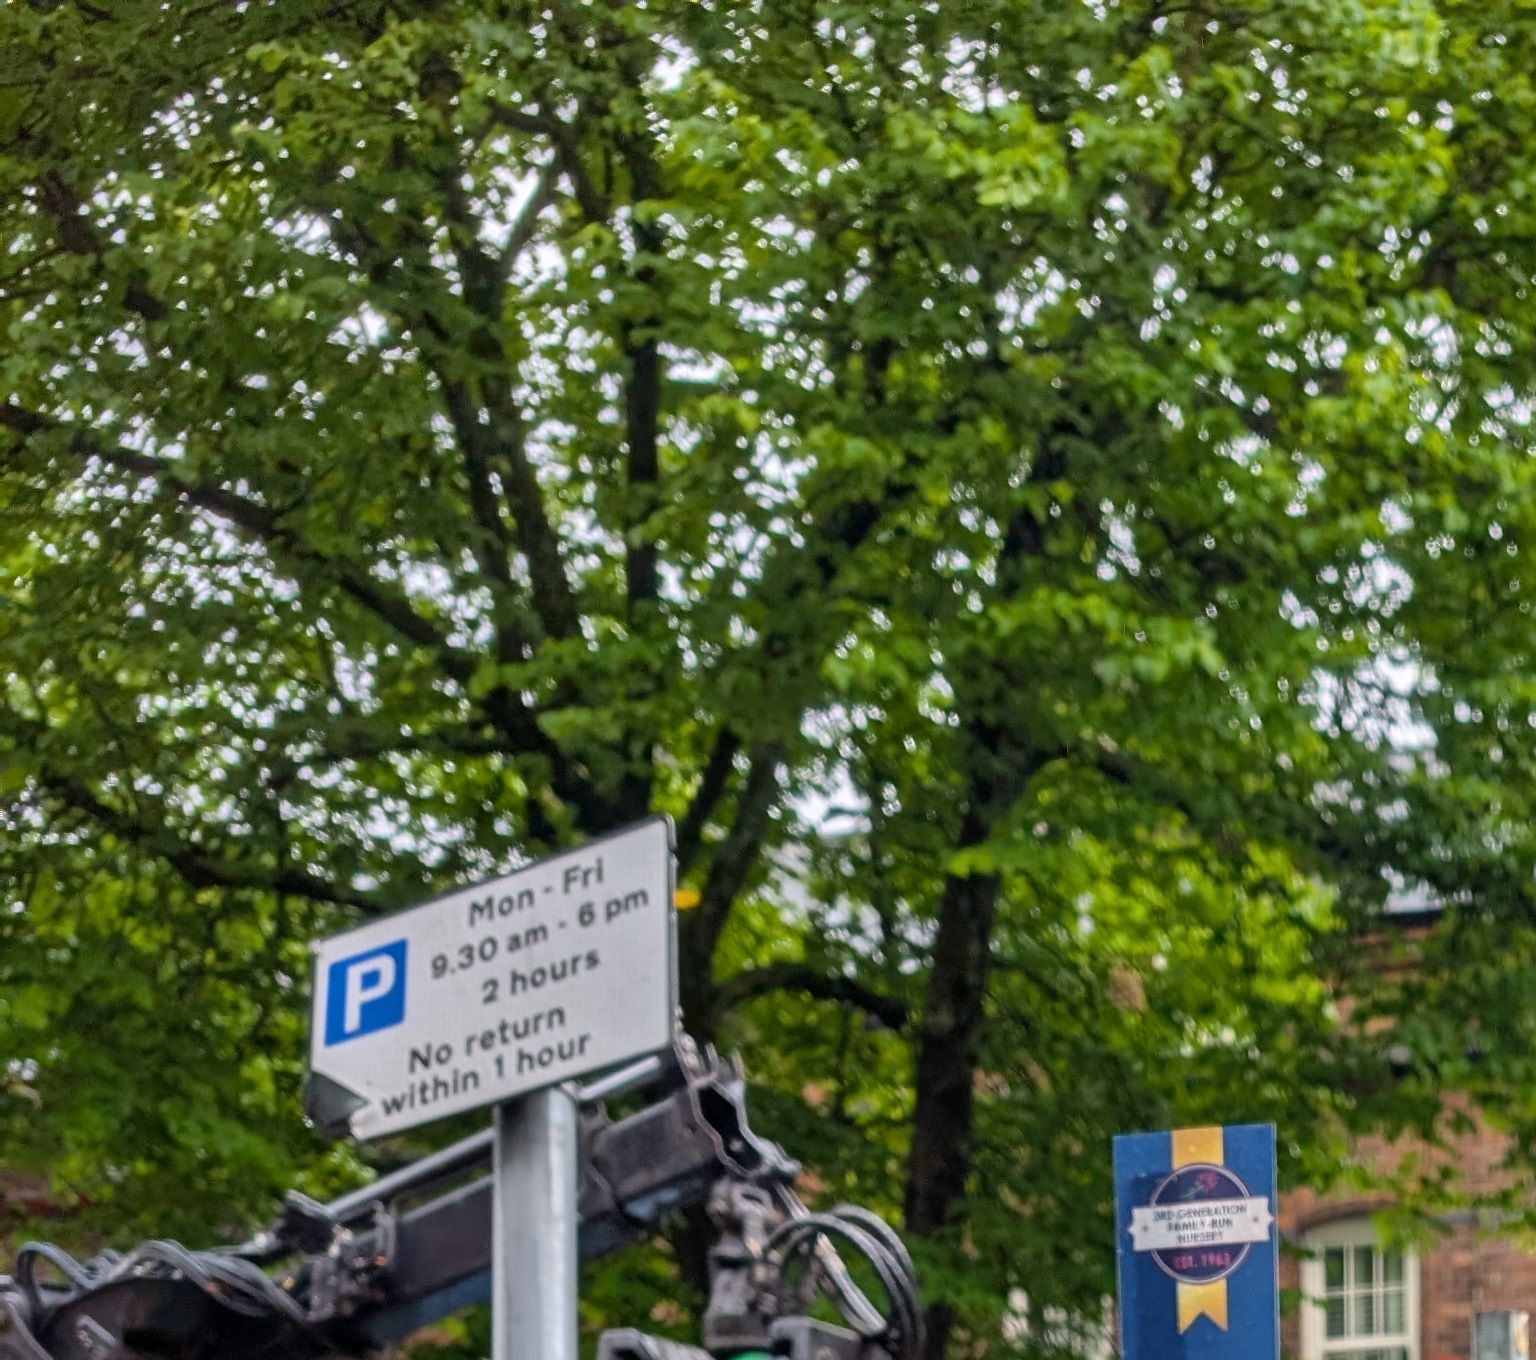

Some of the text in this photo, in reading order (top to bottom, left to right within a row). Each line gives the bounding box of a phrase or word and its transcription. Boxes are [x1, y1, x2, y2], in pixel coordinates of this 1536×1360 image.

[468, 888, 535, 927] Mon
[562, 857, 605, 895] Fri
[430, 937, 498, 979] 9.30
[506, 926, 548, 953] am
[577, 901, 597, 929] 6
[605, 887, 650, 923] pm
[344, 954, 396, 1034] P
[481, 949, 600, 1004] 2 hours
[381, 1032, 591, 1117] within 1 hour
[407, 1006, 565, 1074] No return
